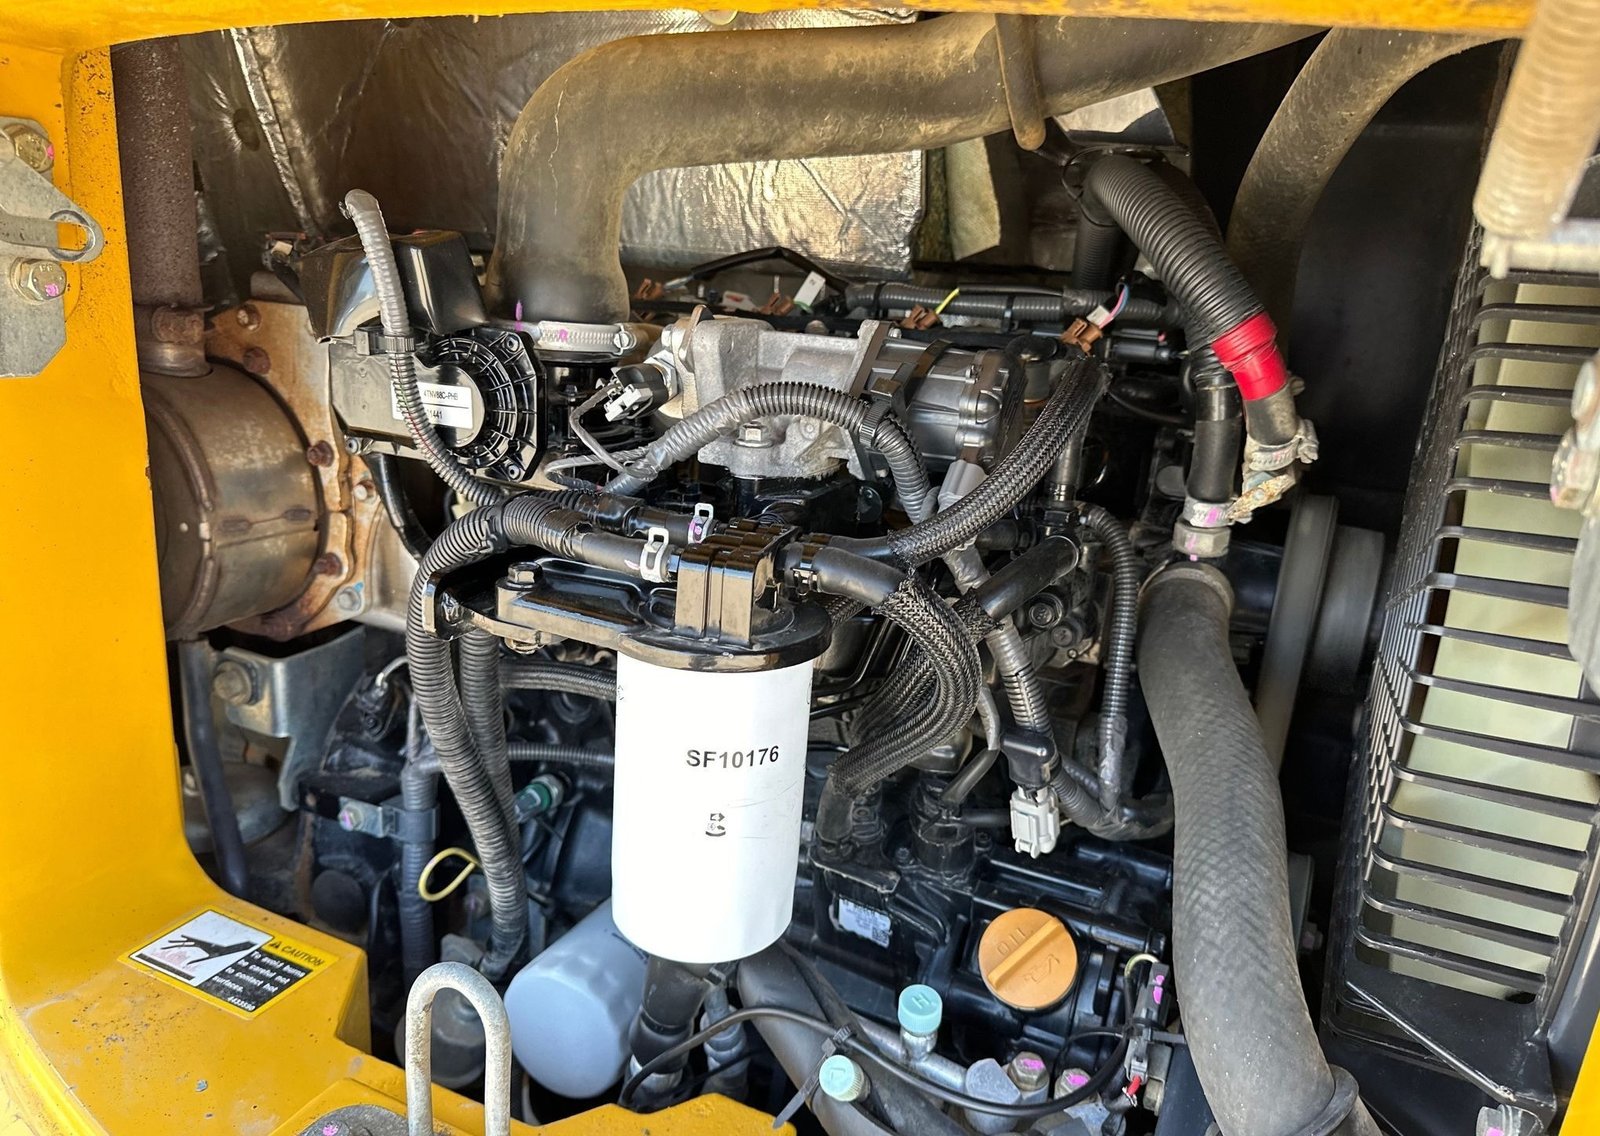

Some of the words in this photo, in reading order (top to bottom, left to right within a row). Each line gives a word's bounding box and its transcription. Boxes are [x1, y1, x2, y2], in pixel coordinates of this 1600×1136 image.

[686, 745, 780, 769] SF10176
[251, 951, 262, 960] To
[282, 964, 306, 978] burns
[282, 946, 324, 966] CAUTION
[237, 959, 249, 967] be
[248, 964, 277, 978] careful
[234, 971, 264, 987] contact
[262, 982, 279, 993] hot
[912, 993, 929, 1009] H
